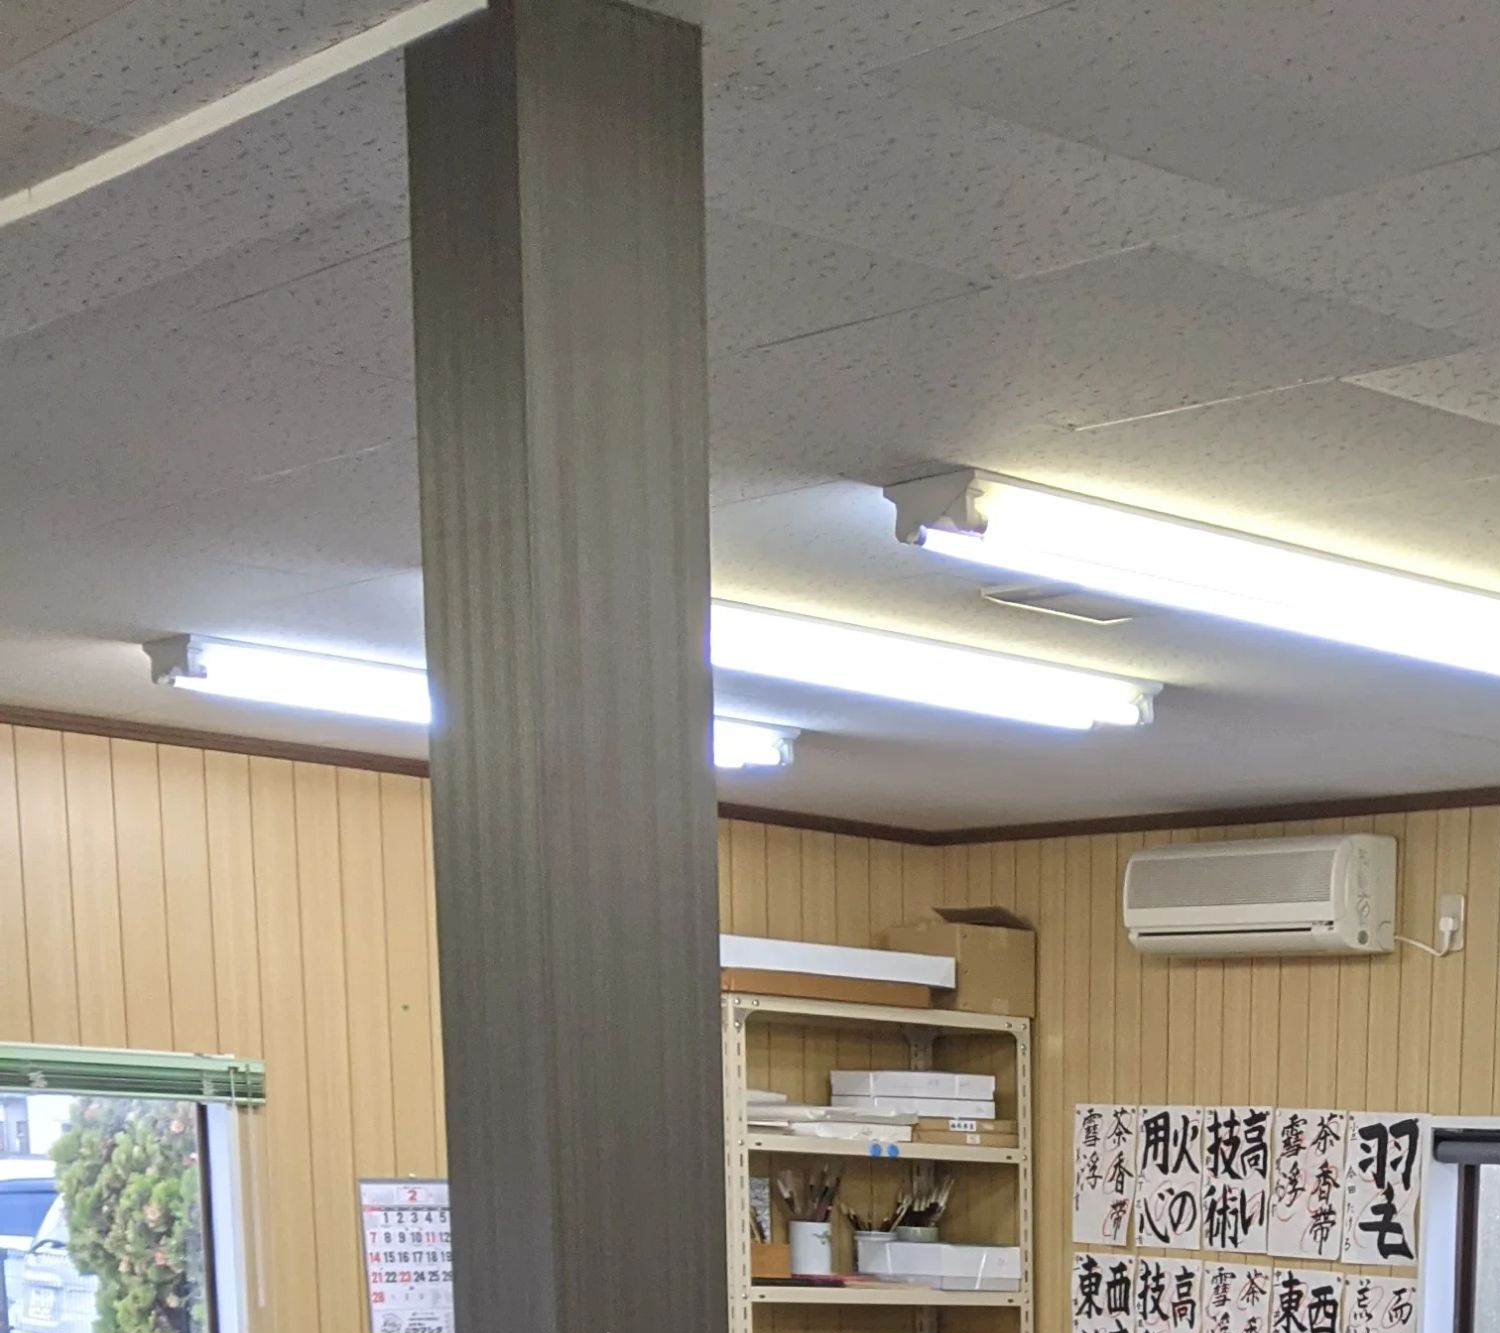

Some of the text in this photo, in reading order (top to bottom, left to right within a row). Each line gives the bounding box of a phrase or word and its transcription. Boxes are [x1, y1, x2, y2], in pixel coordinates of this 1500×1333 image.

[1141, 1111, 1175, 1243] 用心
[1168, 1114, 1200, 1232] 火の
[1204, 1108, 1243, 1249] 技術
[1240, 1108, 1268, 1236] 高い
[1358, 1118, 1419, 1259] 羽毛
[369, 1252, 380, 1264] 14
[384, 1252, 395, 1264] 15
[398, 1252, 409, 1264] 16
[412, 1252, 423, 1264] 17
[426, 1252, 438, 1264] 18
[385, 1272, 397, 1284] 22
[414, 1271, 426, 1283] 24
[428, 1271, 440, 1283] 25
[411, 1232, 422, 1243] 10
